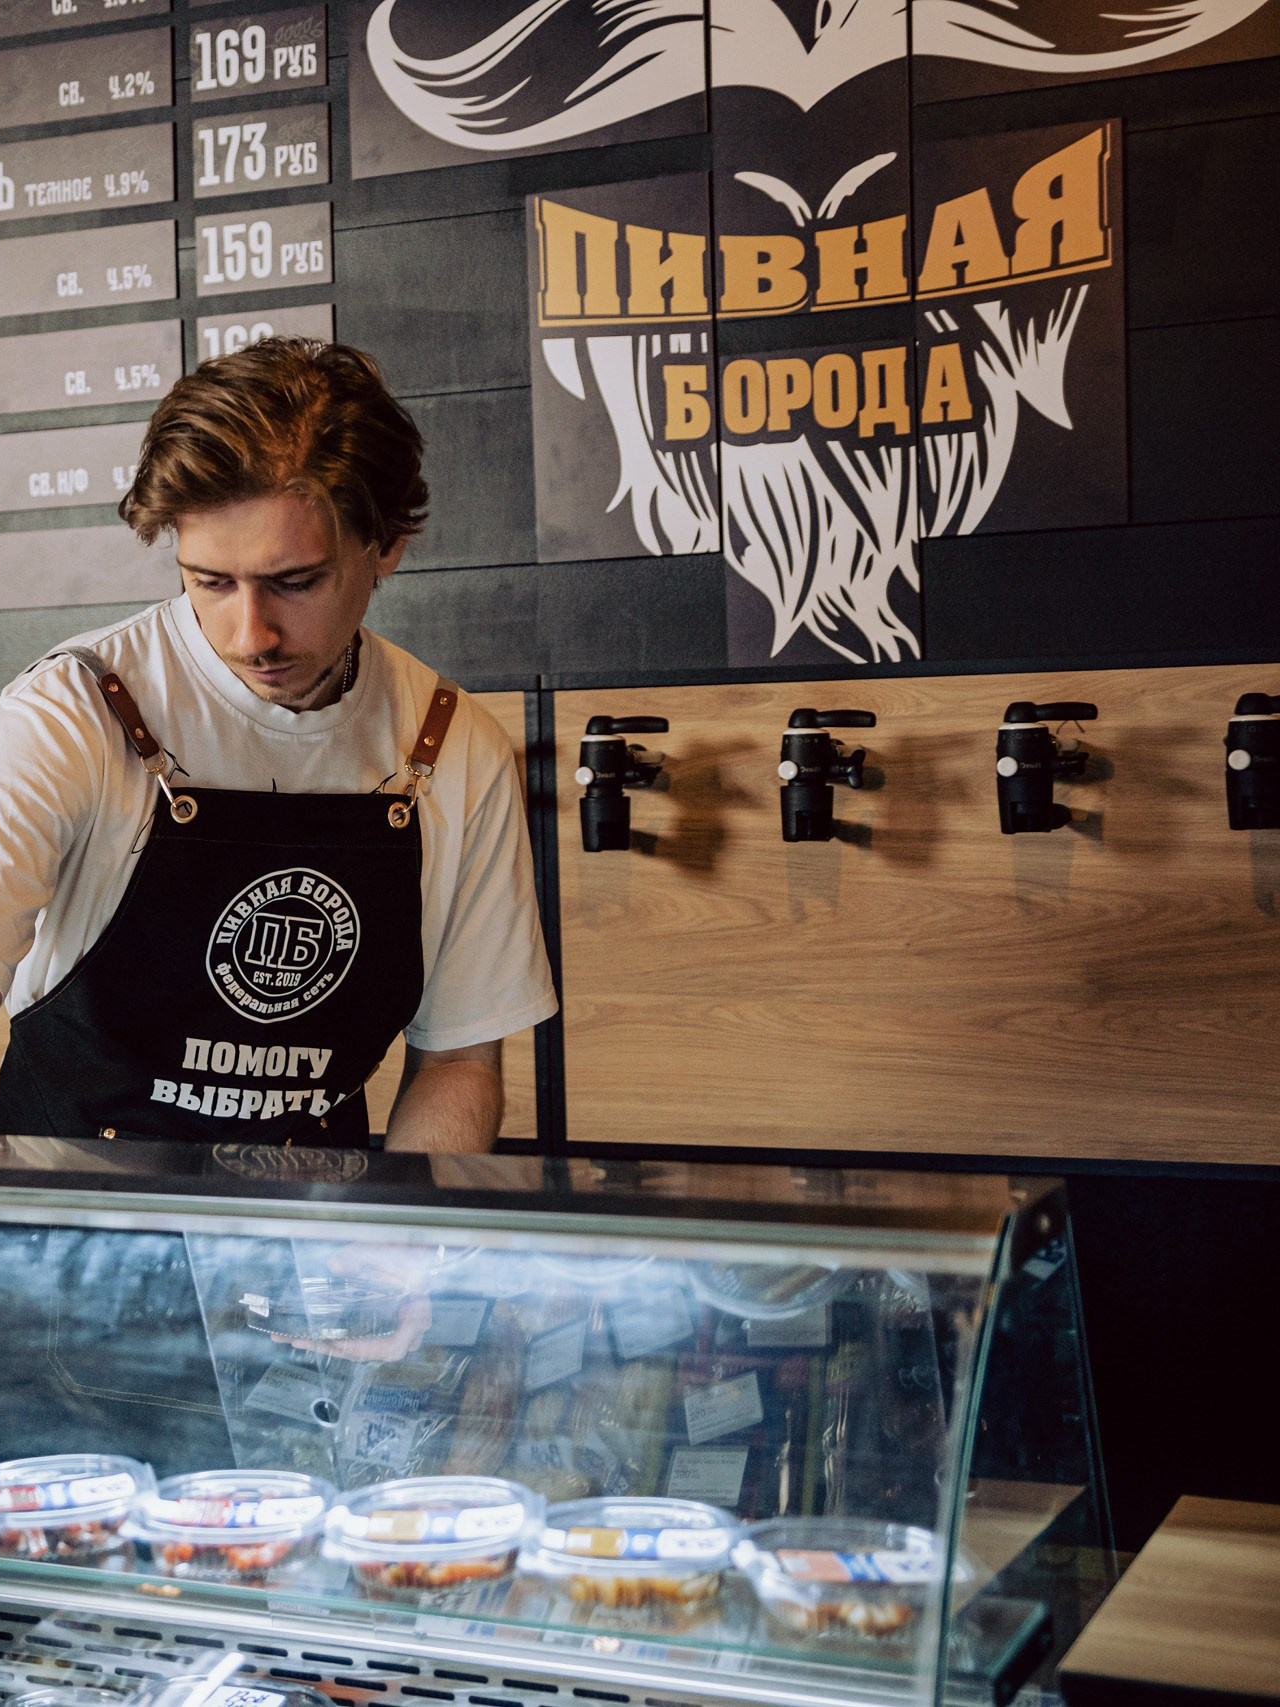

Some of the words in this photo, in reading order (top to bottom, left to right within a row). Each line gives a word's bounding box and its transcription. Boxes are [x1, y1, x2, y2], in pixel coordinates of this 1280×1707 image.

[195, 25, 267, 91] 169
[274, 43, 318, 80] РУБ
[58, 81, 85, 106] СВ.
[109, 71, 155, 99] 4.2%
[198, 122, 268, 187] 173
[274, 142, 318, 177] РУБ
[25, 176, 92, 207] ТЕМНОЕ
[104, 170, 149, 197] 4.9%
[537, 126, 1108, 321] ПИВНАЯ
[56, 272, 83, 297] СВ.
[106, 264, 152, 292] 4.5%
[201, 221, 273, 285] 159
[280, 240, 325, 276] РУБ
[64, 371, 92, 396] СВ.
[114, 363, 160, 391] 4.5%
[662, 341, 973, 441] БОРОДА
[216, 876, 293, 944] ПИВНАЯ
[297, 875, 355, 952] БОРОДА
[244, 912, 325, 970] ПБ
[215, 962, 300, 1014] федеральная
[303, 972, 334, 1001] сеть
[275, 971, 302, 987] 2019
[182, 1037, 333, 1079] ПОМОГУ
